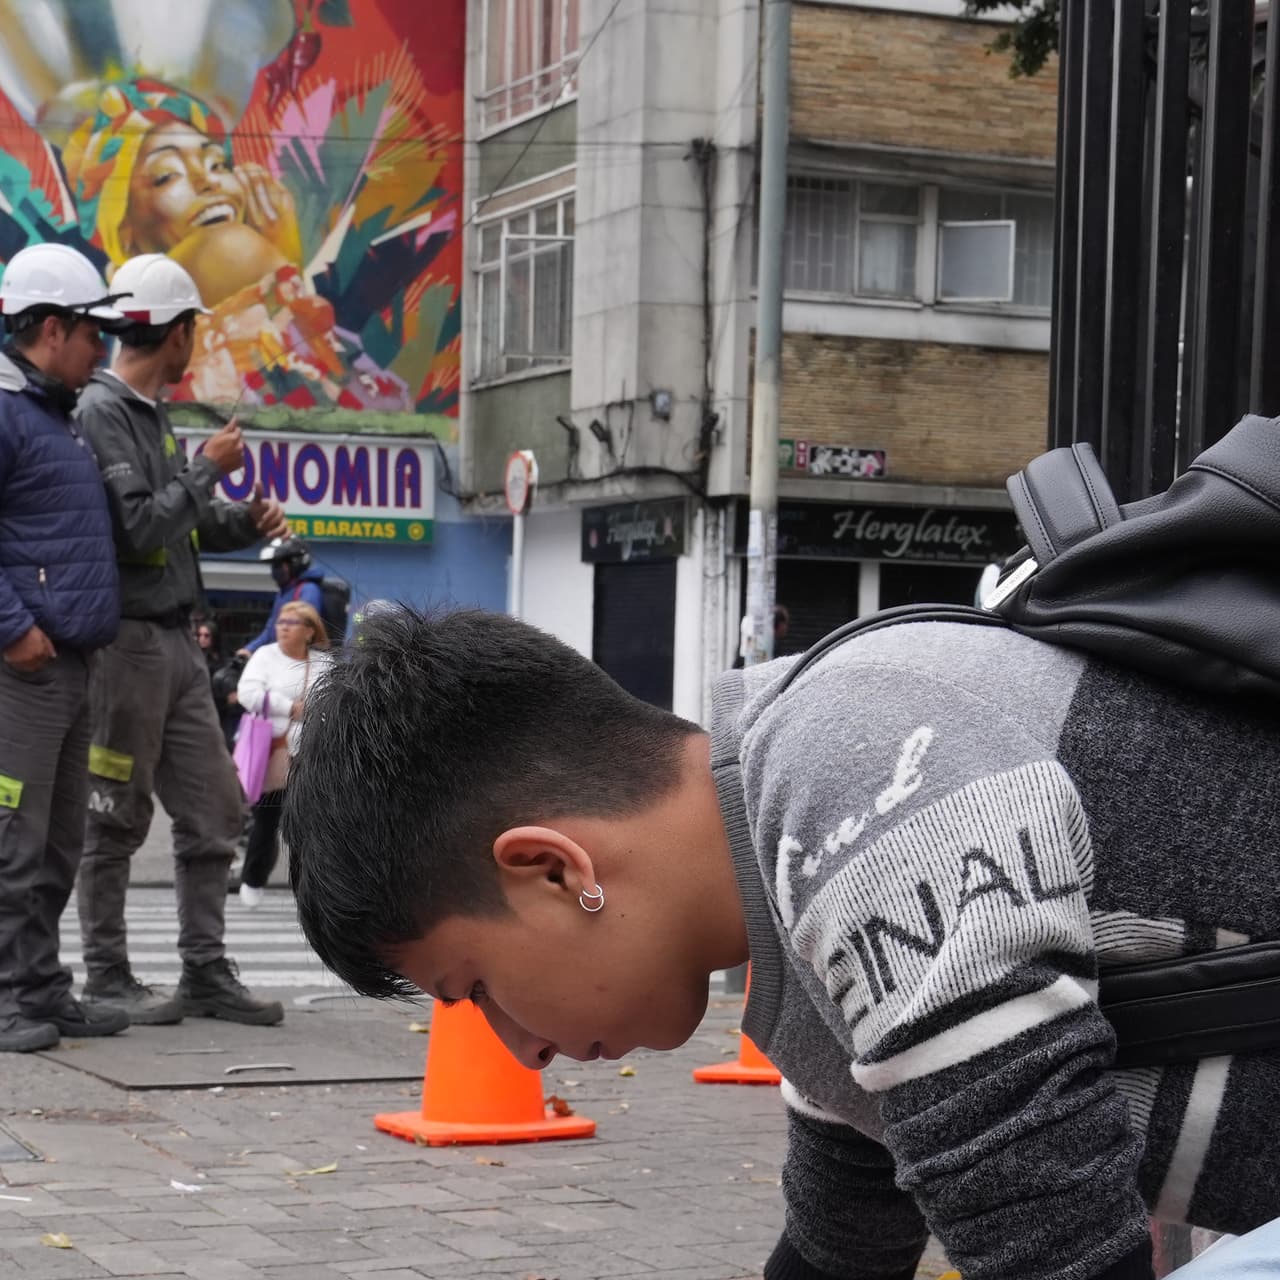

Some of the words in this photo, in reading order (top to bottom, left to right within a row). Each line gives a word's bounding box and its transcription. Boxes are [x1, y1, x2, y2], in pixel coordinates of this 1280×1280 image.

[177, 437, 422, 508] ONOMIA
[313, 519, 397, 539] BARATAS
[833, 509, 988, 558] Herglatex
